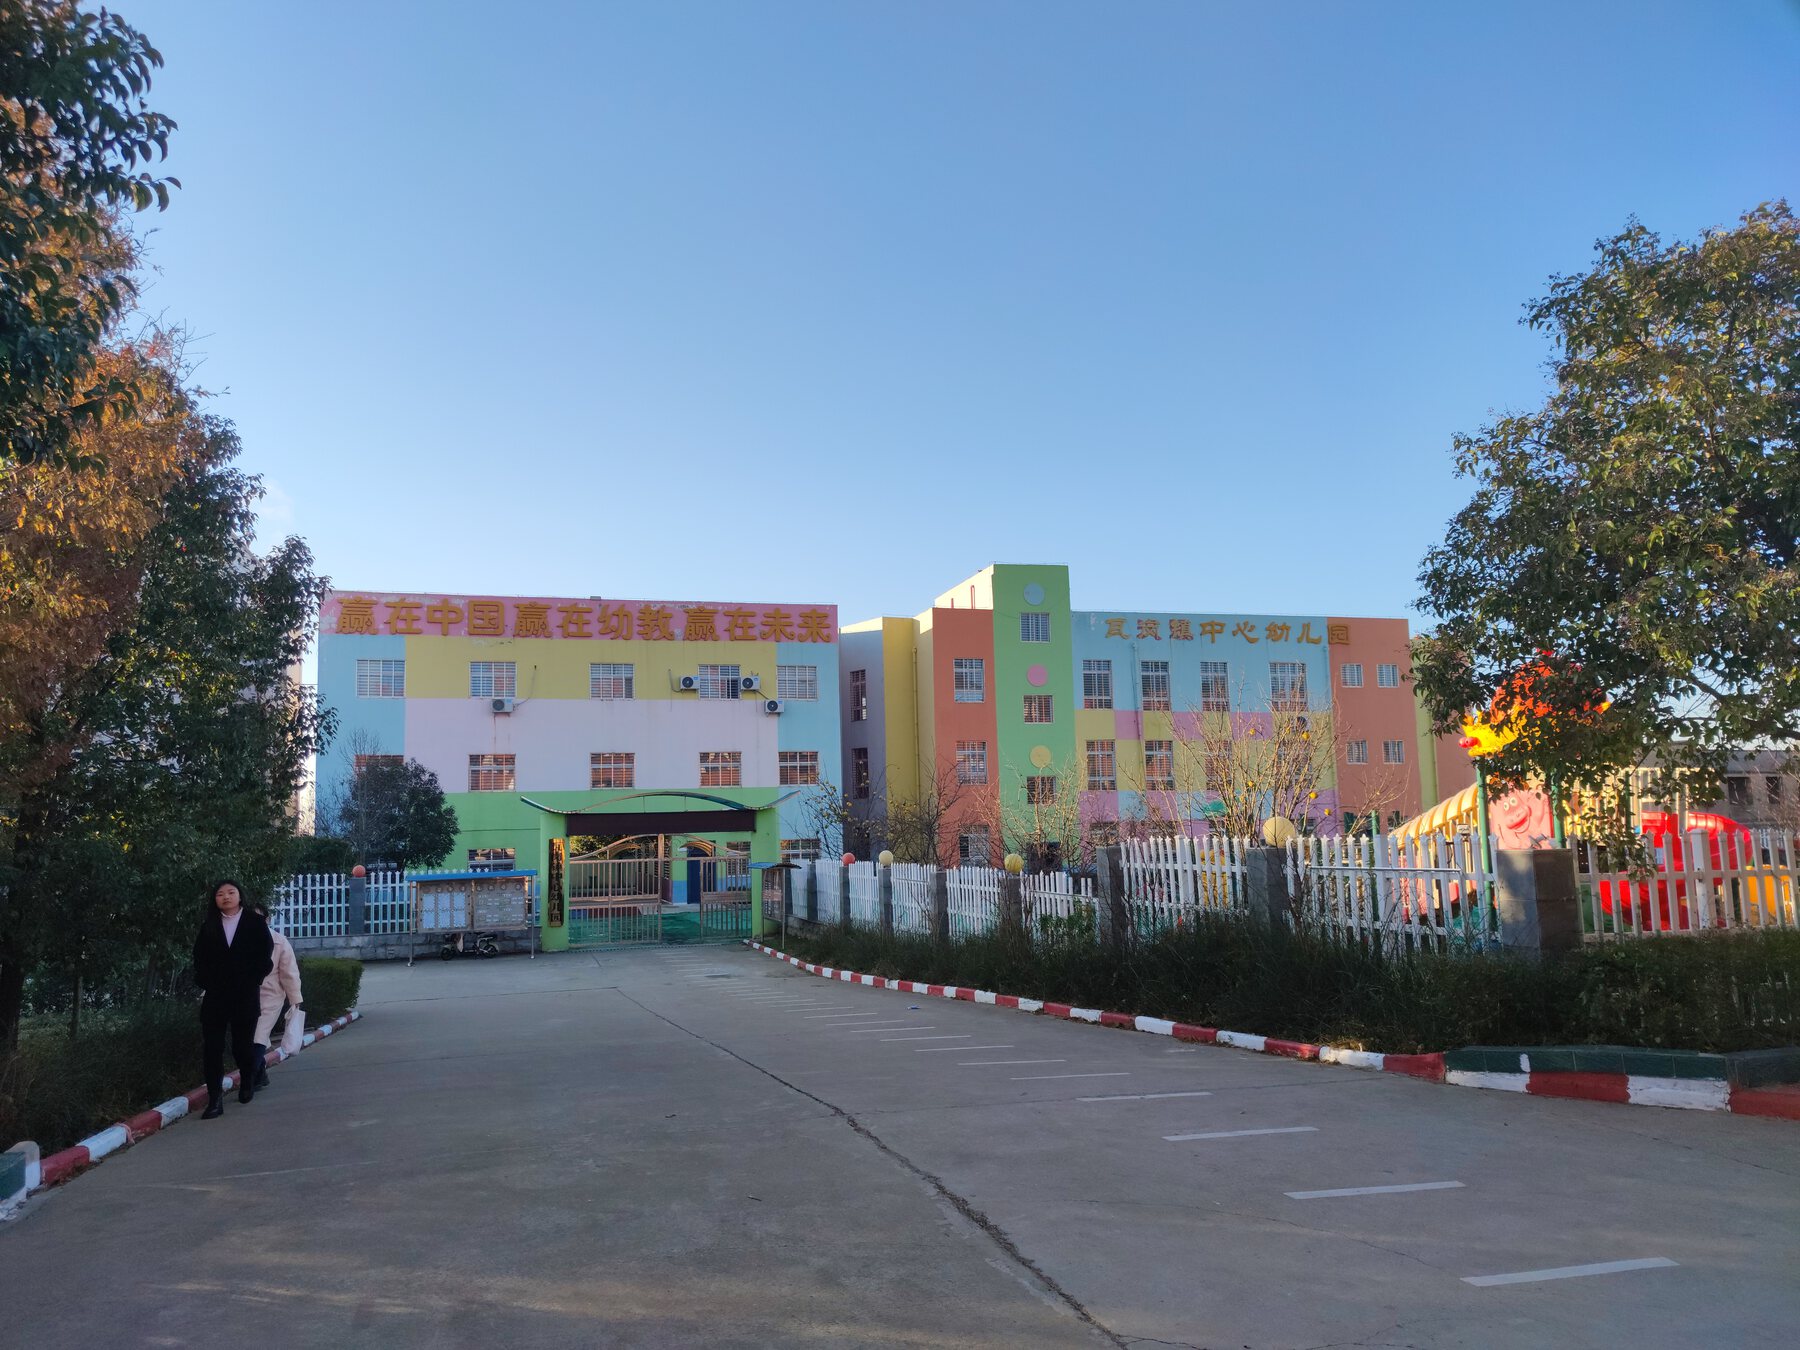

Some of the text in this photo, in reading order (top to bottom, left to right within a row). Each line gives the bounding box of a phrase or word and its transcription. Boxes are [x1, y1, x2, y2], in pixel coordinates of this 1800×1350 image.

[336, 597, 831, 643] 赢在中国赢在幼教赢在未来
